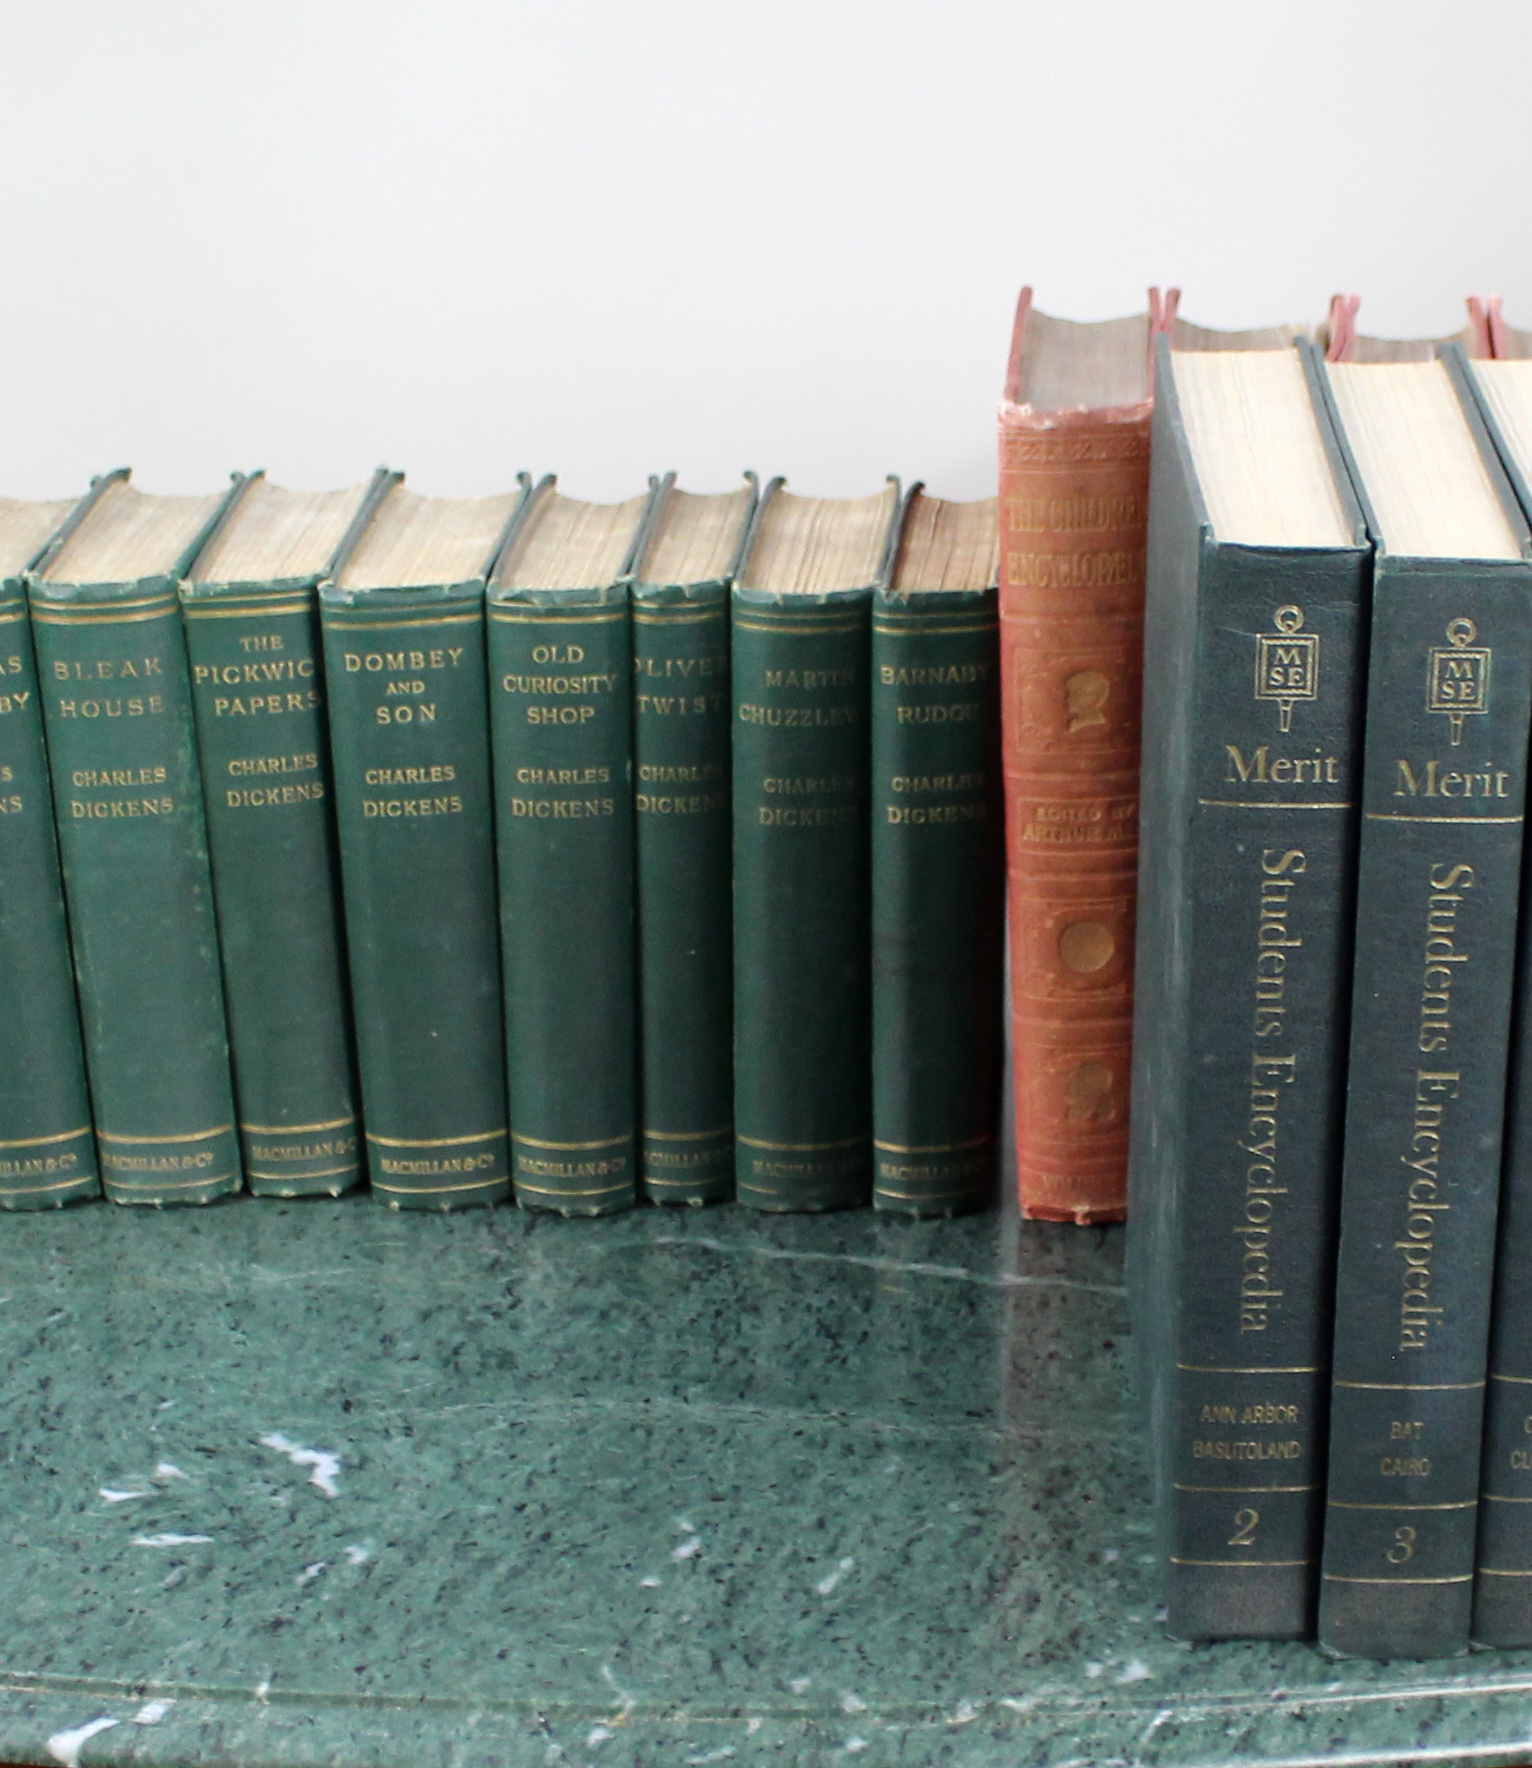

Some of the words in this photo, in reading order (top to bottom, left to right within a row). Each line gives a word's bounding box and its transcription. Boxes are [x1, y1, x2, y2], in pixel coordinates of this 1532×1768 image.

[239, 635, 285, 652] THE
[532, 645, 585, 664] OLD
[344, 648, 464, 672] DOMBEY
[1273, 647, 1302, 666] M
[54, 657, 164, 681] BLEAK
[194, 658, 315, 685] PICKWIC
[1270, 667, 1306, 687] SE
[1444, 660, 1475, 679] M
[386, 681, 426, 695] AND
[503, 674, 616, 695] CURIOSITY
[1441, 680, 1476, 700] SE
[59, 696, 166, 720] HOUSE
[214, 690, 322, 717] PAPERS
[376, 703, 436, 725] SON
[527, 706, 596, 725] SHOP
[228, 753, 318, 777] CHARLES
[365, 765, 456, 785] CHARLES
[1225, 745, 1339, 784] Merit
[72, 767, 167, 789] CHARLES
[516, 768, 610, 785] CHARLES
[1393, 759, 1509, 798] Merit
[227, 782, 324, 808] DICKENS
[362, 795, 463, 817] DICKENS
[70, 798, 174, 820] DICKENS
[511, 797, 615, 818] DICKENS
[1254, 848, 1308, 1039] Students
[1417, 863, 1475, 1054] Students
[1233, 1053, 1297, 1335] Encyclopedia
[1394, 1069, 1461, 1353] Encyclopedia
[1199, 1405, 1236, 1424] ANN
[1242, 1404, 1299, 1424] ARBOR
[1390, 1421, 1424, 1440] BAT
[1192, 1441, 1301, 1461] BASUTOLAND
[1380, 1458, 1431, 1477] CAIRO
[1228, 1508, 1260, 1546] 2
[1386, 1526, 1417, 1564] 3
